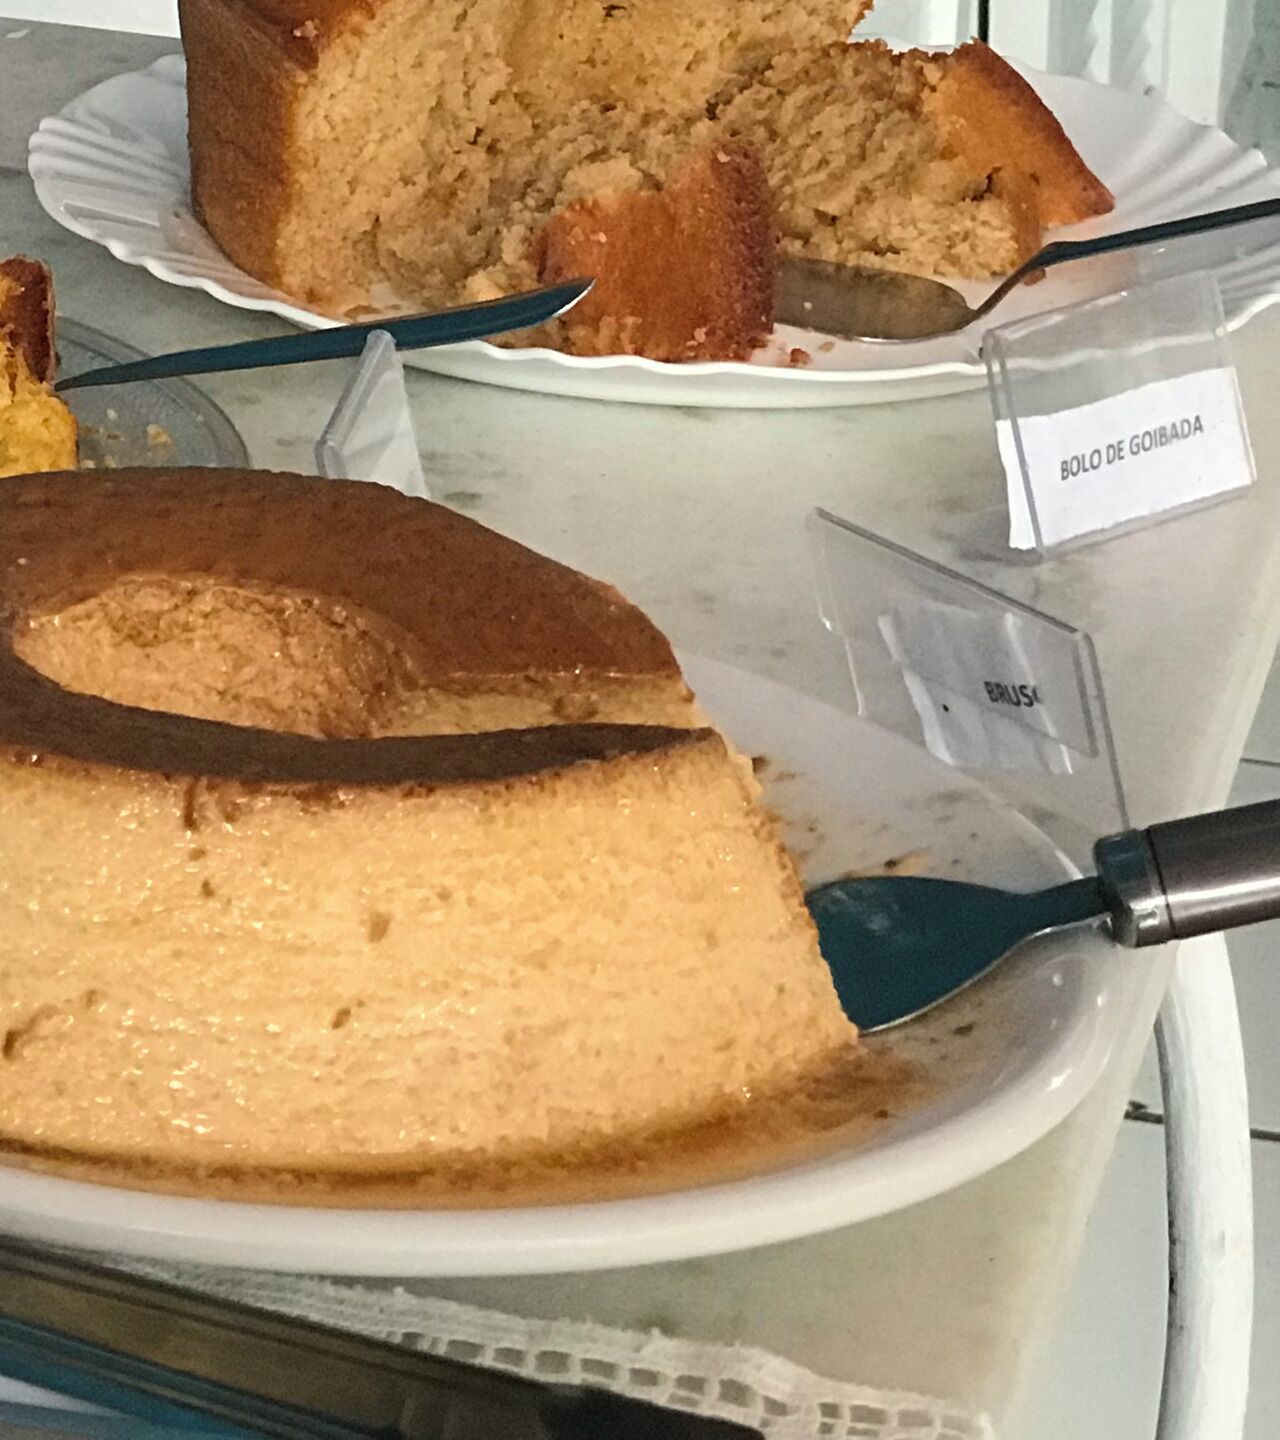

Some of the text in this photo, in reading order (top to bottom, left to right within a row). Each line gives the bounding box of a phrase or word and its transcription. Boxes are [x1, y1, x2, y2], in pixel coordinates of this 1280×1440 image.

[1060, 414, 1204, 482] BOLO DE GOIBADA
